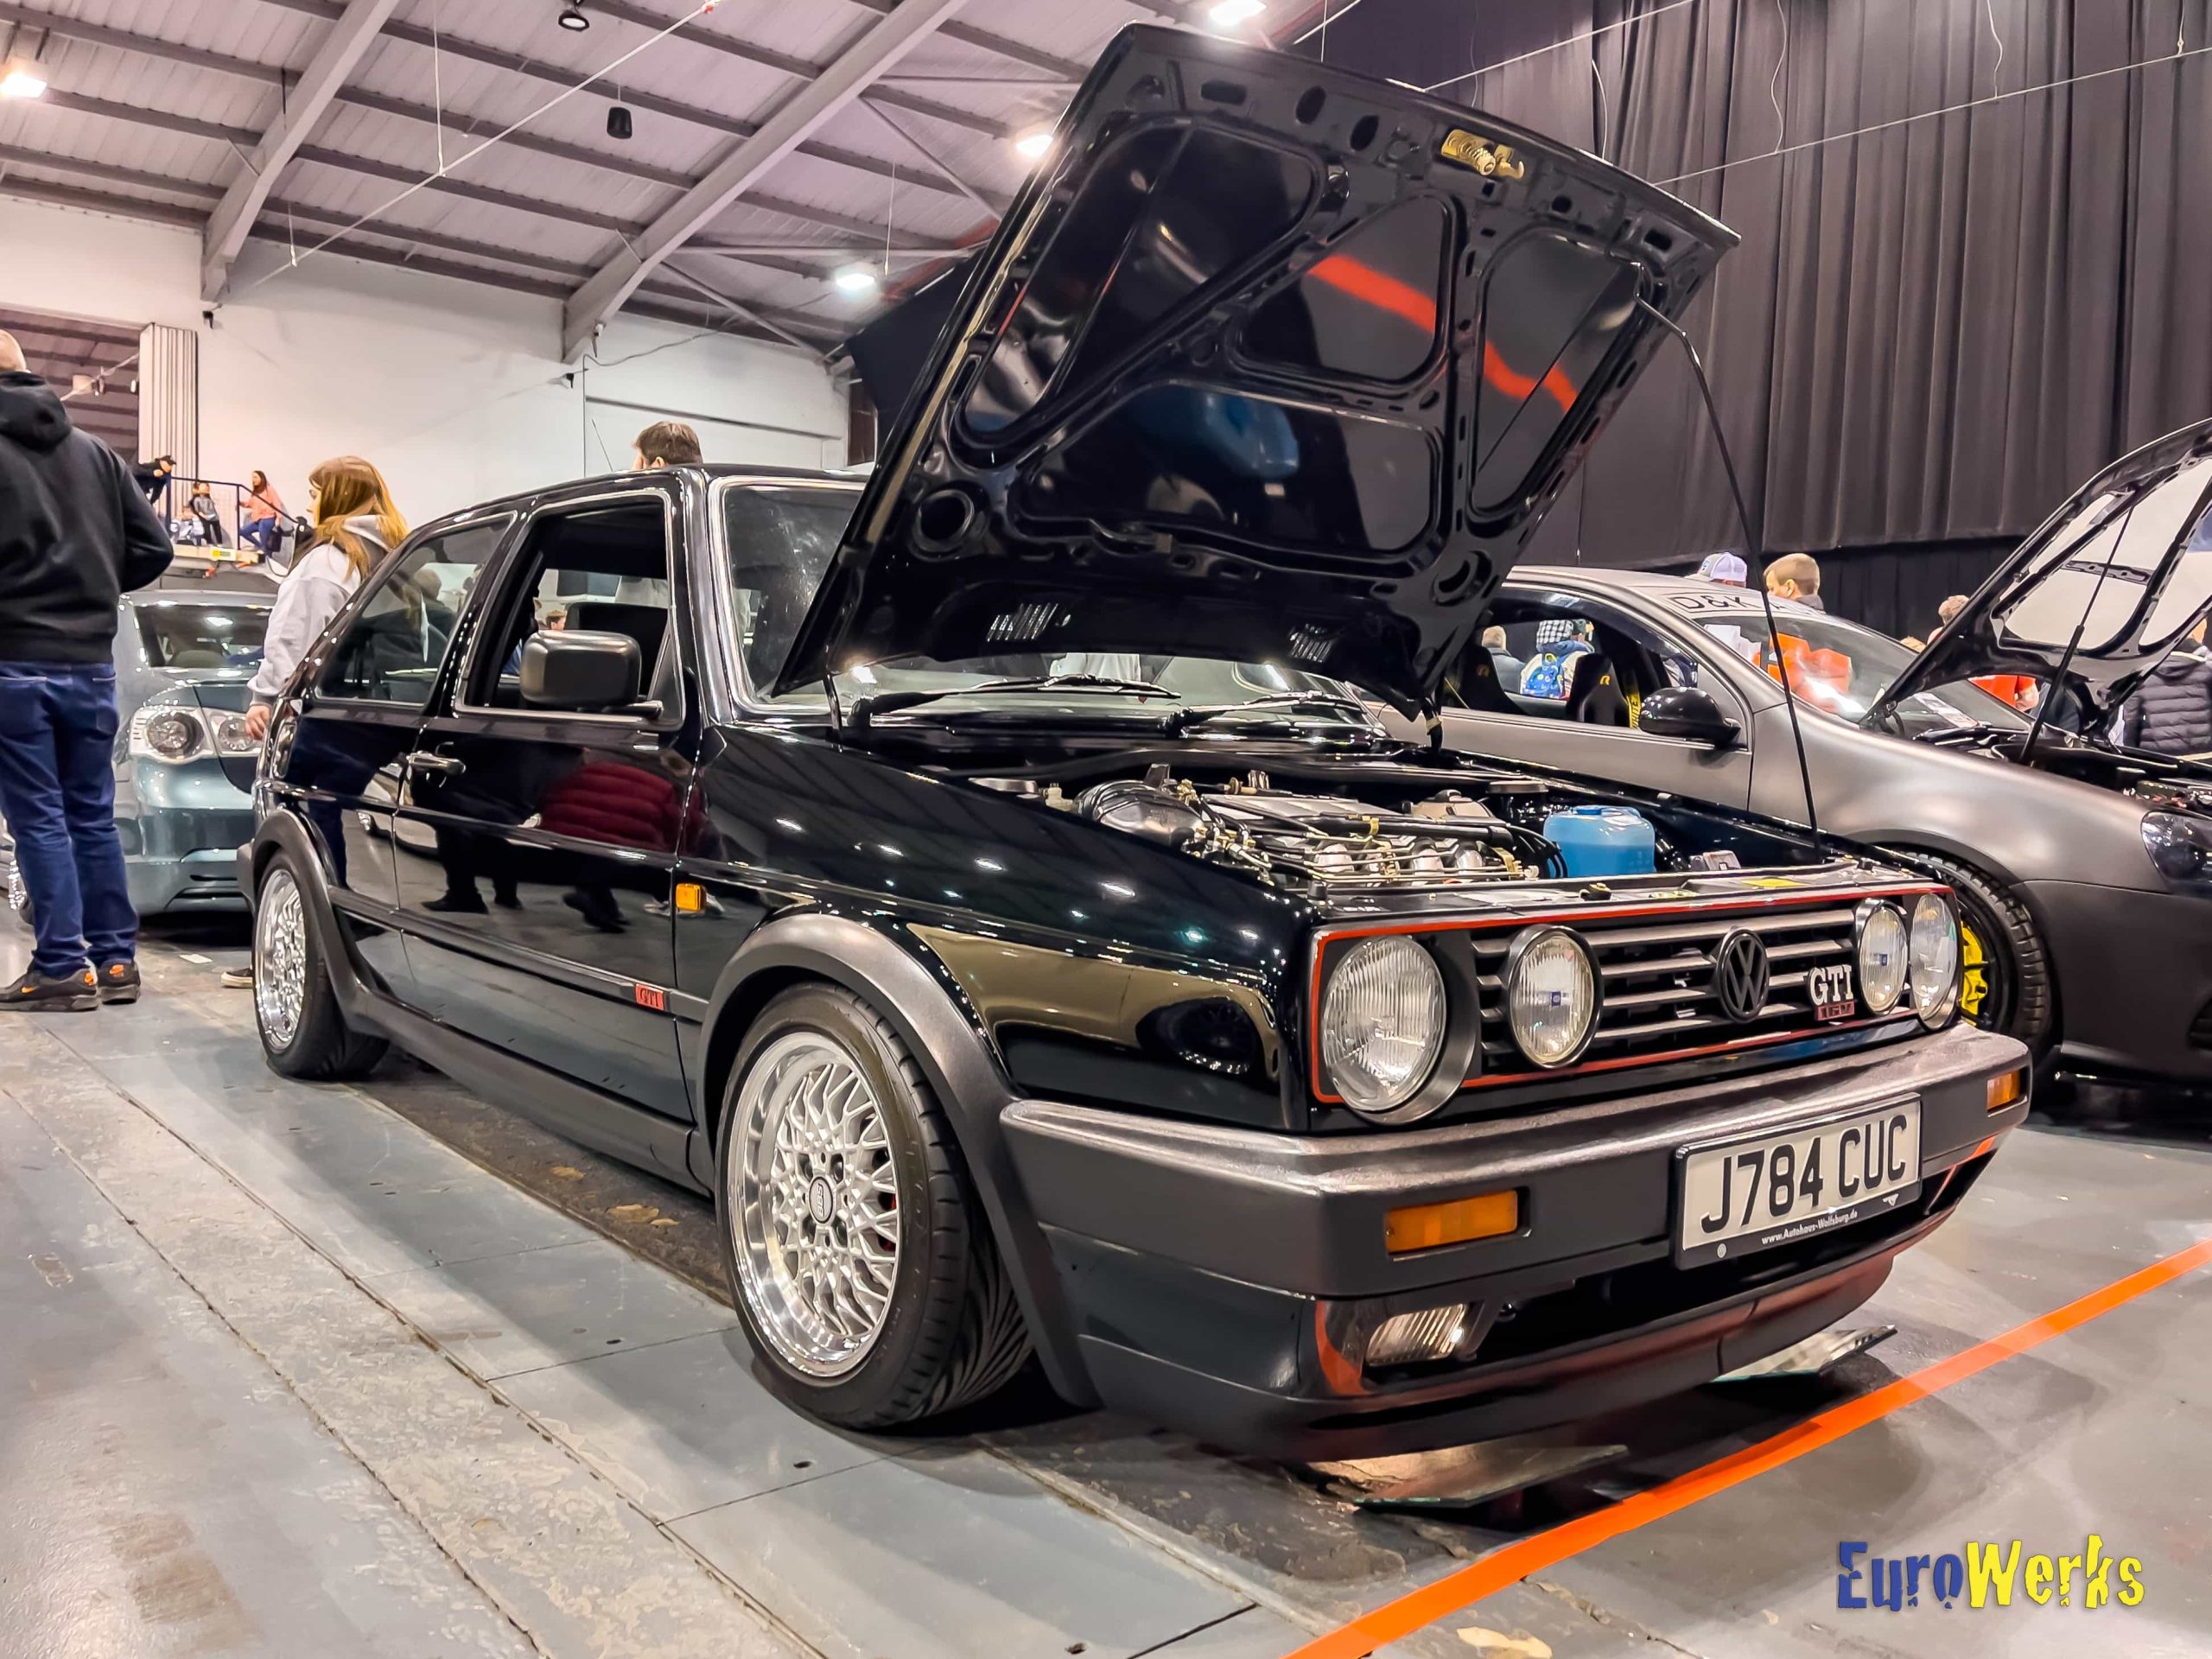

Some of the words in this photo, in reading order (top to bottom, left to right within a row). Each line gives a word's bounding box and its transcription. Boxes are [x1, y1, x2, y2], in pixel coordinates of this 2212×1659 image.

[639, 988, 659, 1007] GTI
[1809, 964, 1853, 1006] GTI
[1700, 1136, 1824, 1234] J784
[1839, 1114, 1907, 1198] CUC
